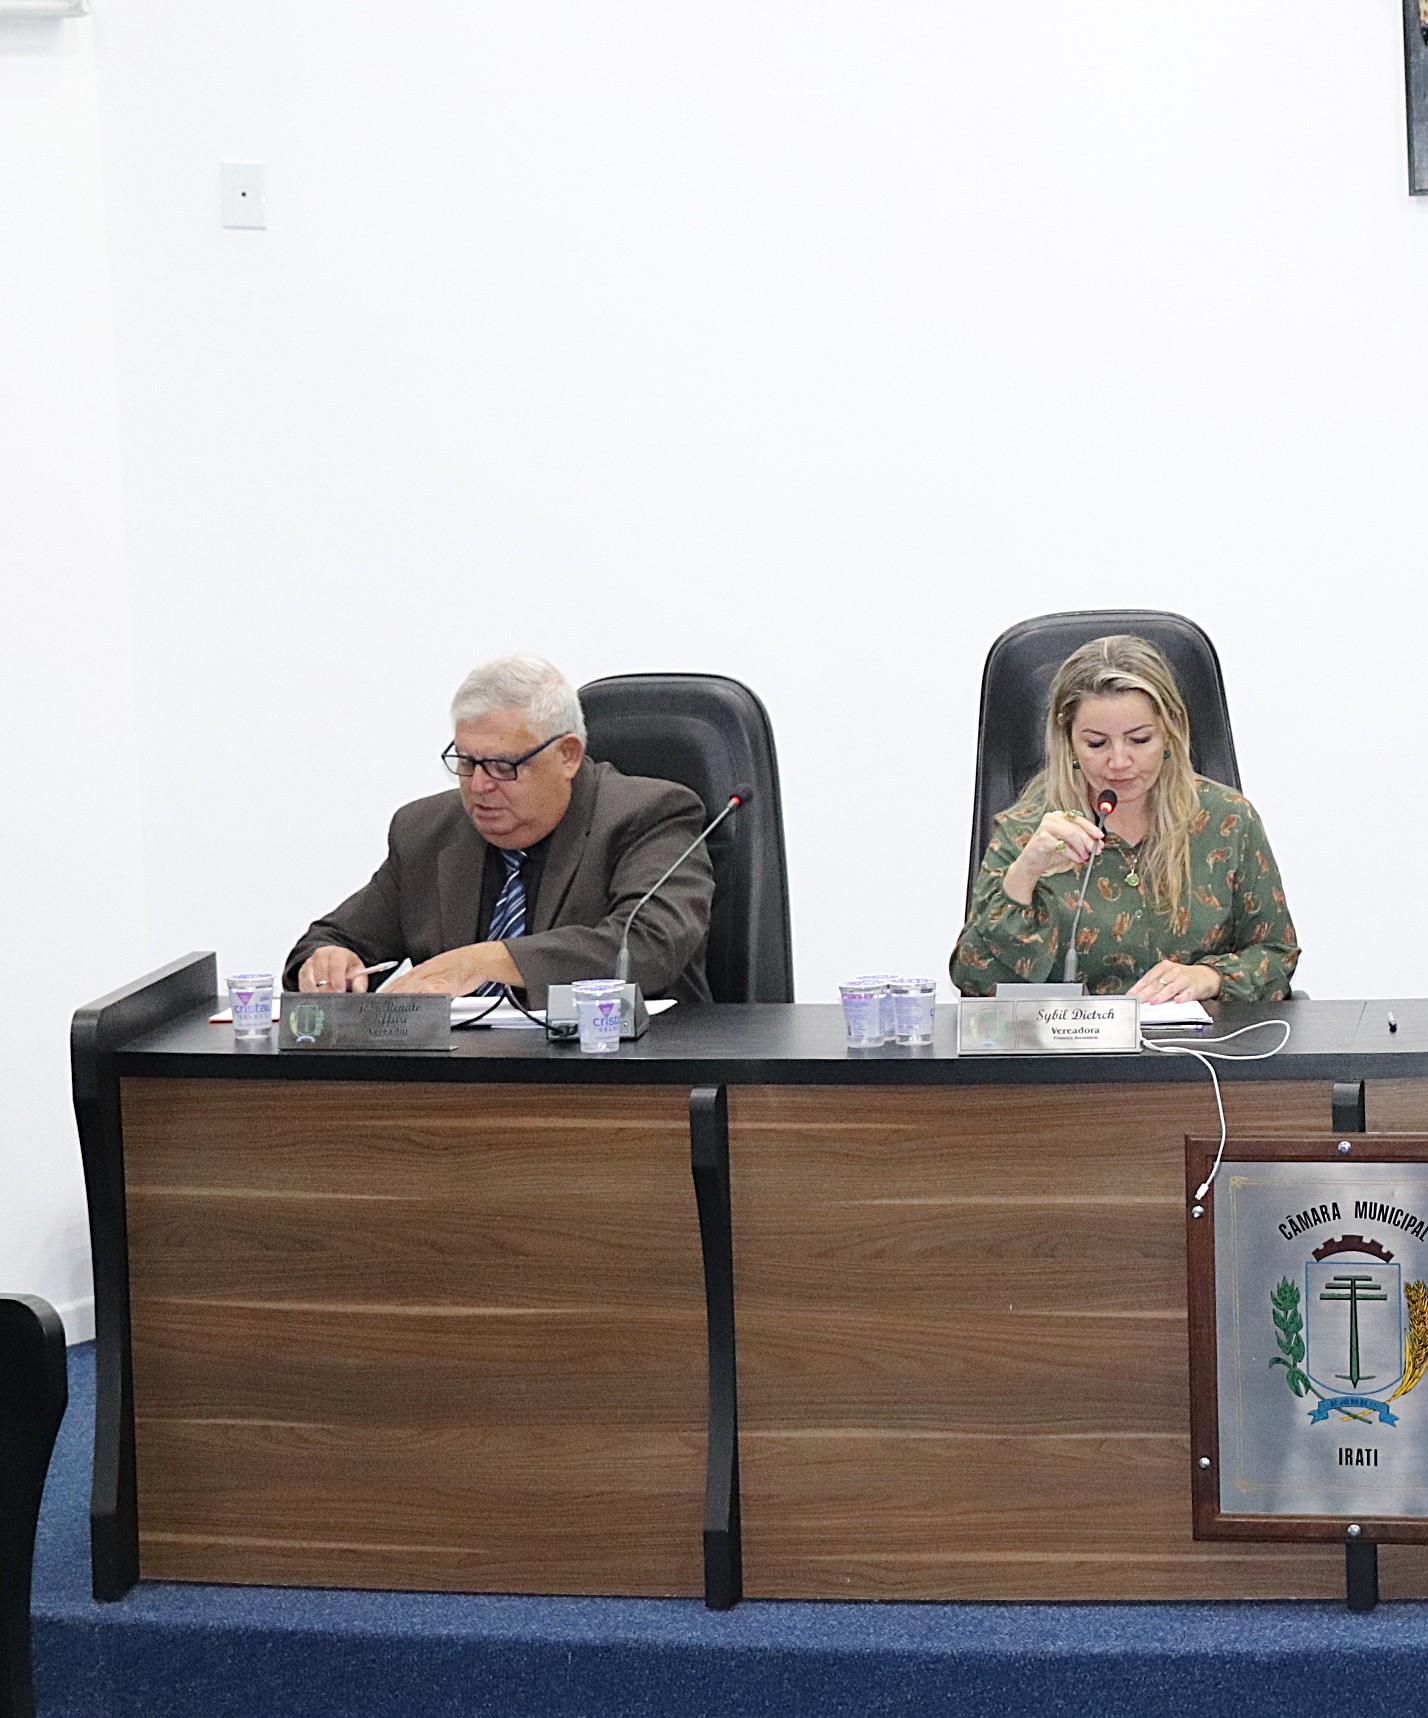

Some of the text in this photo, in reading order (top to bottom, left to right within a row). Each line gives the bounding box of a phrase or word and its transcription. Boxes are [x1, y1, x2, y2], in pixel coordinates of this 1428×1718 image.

[1036, 1008, 1068, 1024] Sybil
[1051, 1027, 1100, 1035] Vereadora
[1278, 1202, 1341, 1241] CÂMARA
[1338, 1447, 1378, 1467] IRATI
